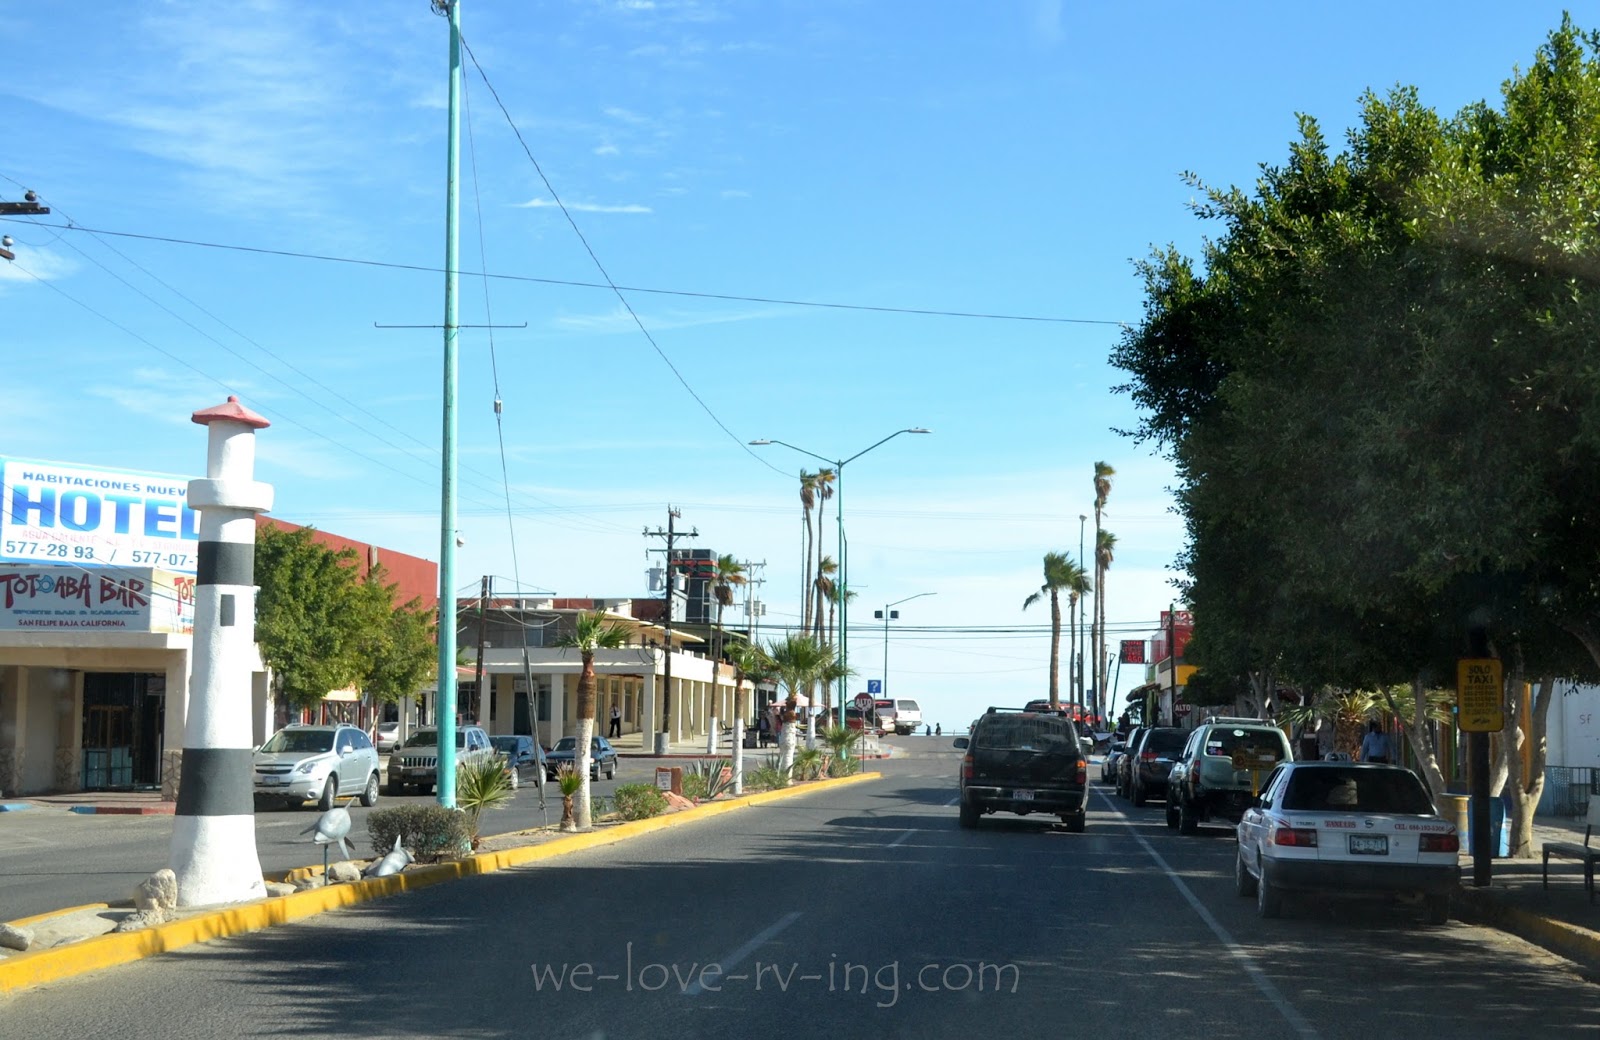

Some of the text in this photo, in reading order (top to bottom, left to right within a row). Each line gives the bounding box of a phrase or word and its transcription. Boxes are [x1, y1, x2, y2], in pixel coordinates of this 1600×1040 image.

[23, 471, 141, 493] HABITACIONES
[11, 484, 200, 541] HOTEL
[6, 540, 68, 557] 577-28
[74, 545, 94, 560] 93
[132, 550, 198, 566] 577-07-
[100, 575, 148, 609] BAR
[18, 619, 34, 627] SAN
[35, 619, 57, 627] FELIPE
[81, 619, 126, 627] CALIFORNIA
[1469, 665, 1491, 674] SOLO
[1467, 674, 1493, 684] TAXI
[856, 698, 872, 706] ALTO
[1175, 704, 1191, 712] ALTO
